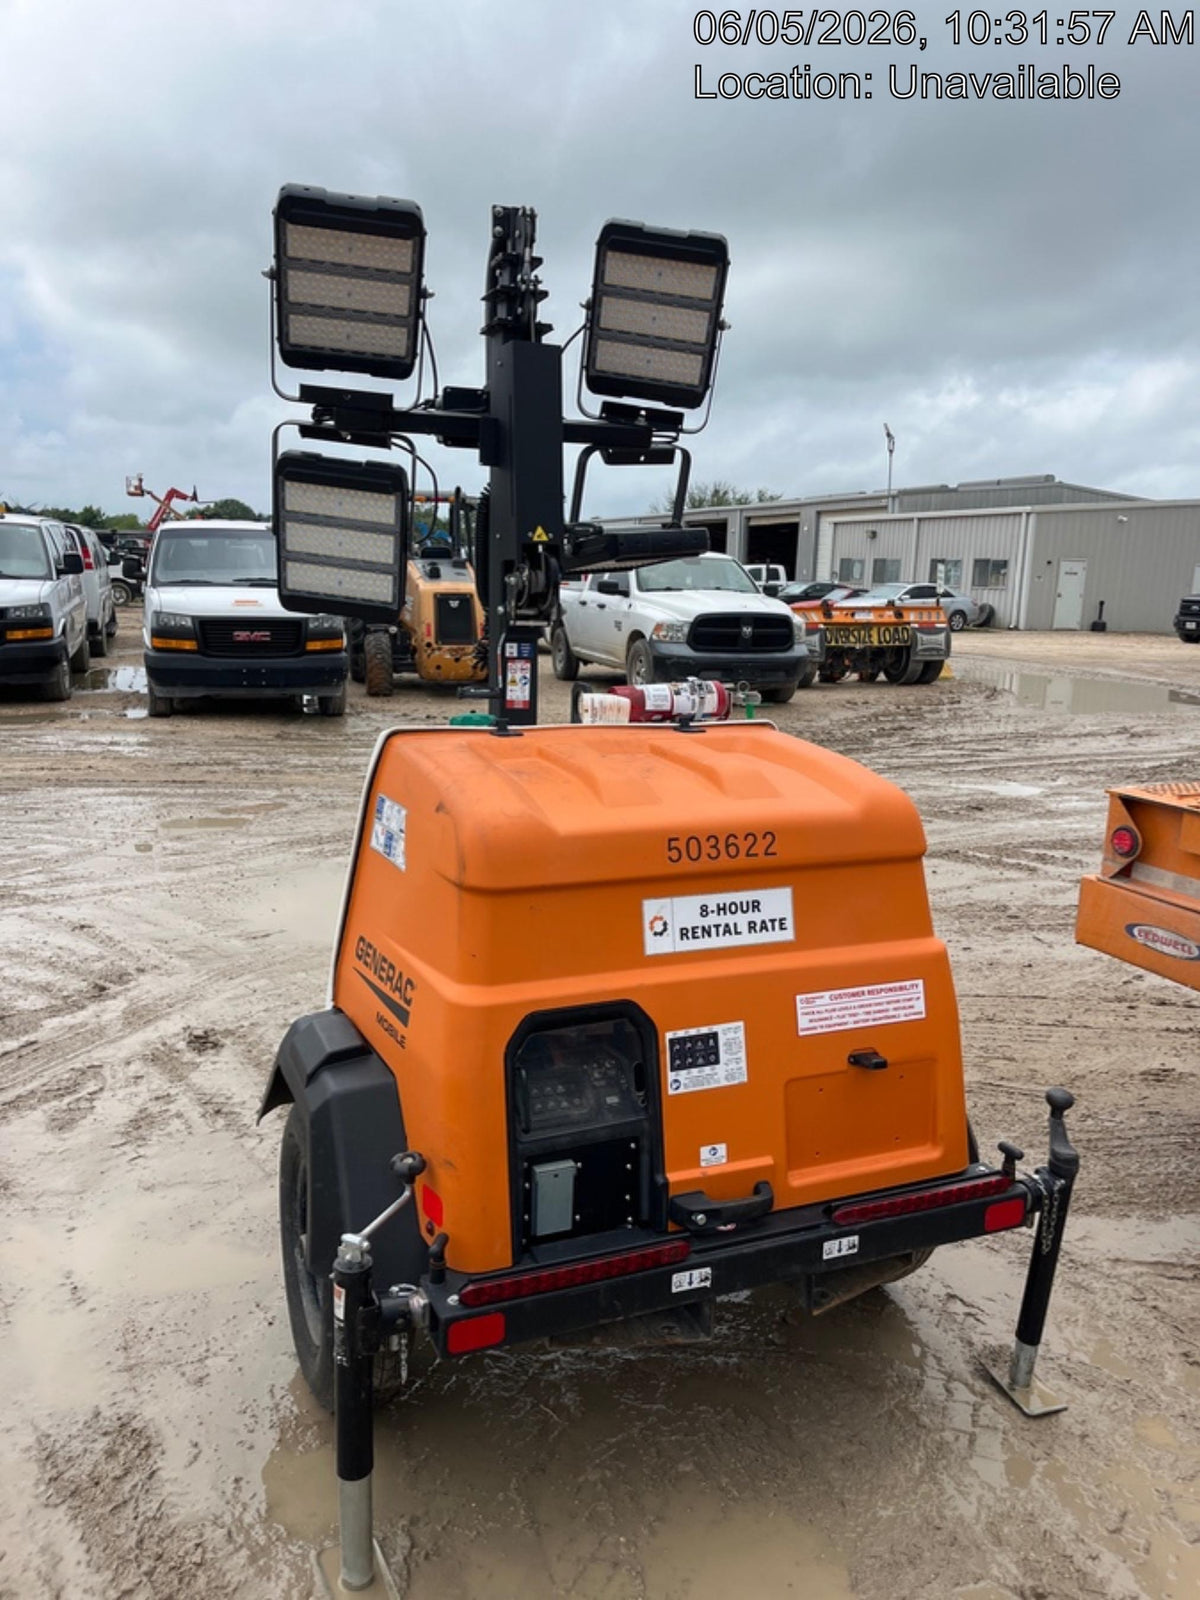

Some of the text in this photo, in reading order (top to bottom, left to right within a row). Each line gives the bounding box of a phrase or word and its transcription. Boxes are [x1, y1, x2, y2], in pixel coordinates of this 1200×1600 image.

[233, 631, 271, 642] GMC
[877, 626, 910, 645] LOAD
[667, 831, 778, 863] 503622
[699, 899, 762, 918] 8-HOUR
[679, 917, 788, 941] RENTAL RATE
[355, 935, 415, 1007] GENERAC
[828, 990, 865, 1001] CUSTOMER
[867, 983, 919, 996] RESPONSIBILITY
[376, 1010, 407, 1050] MOBILE
